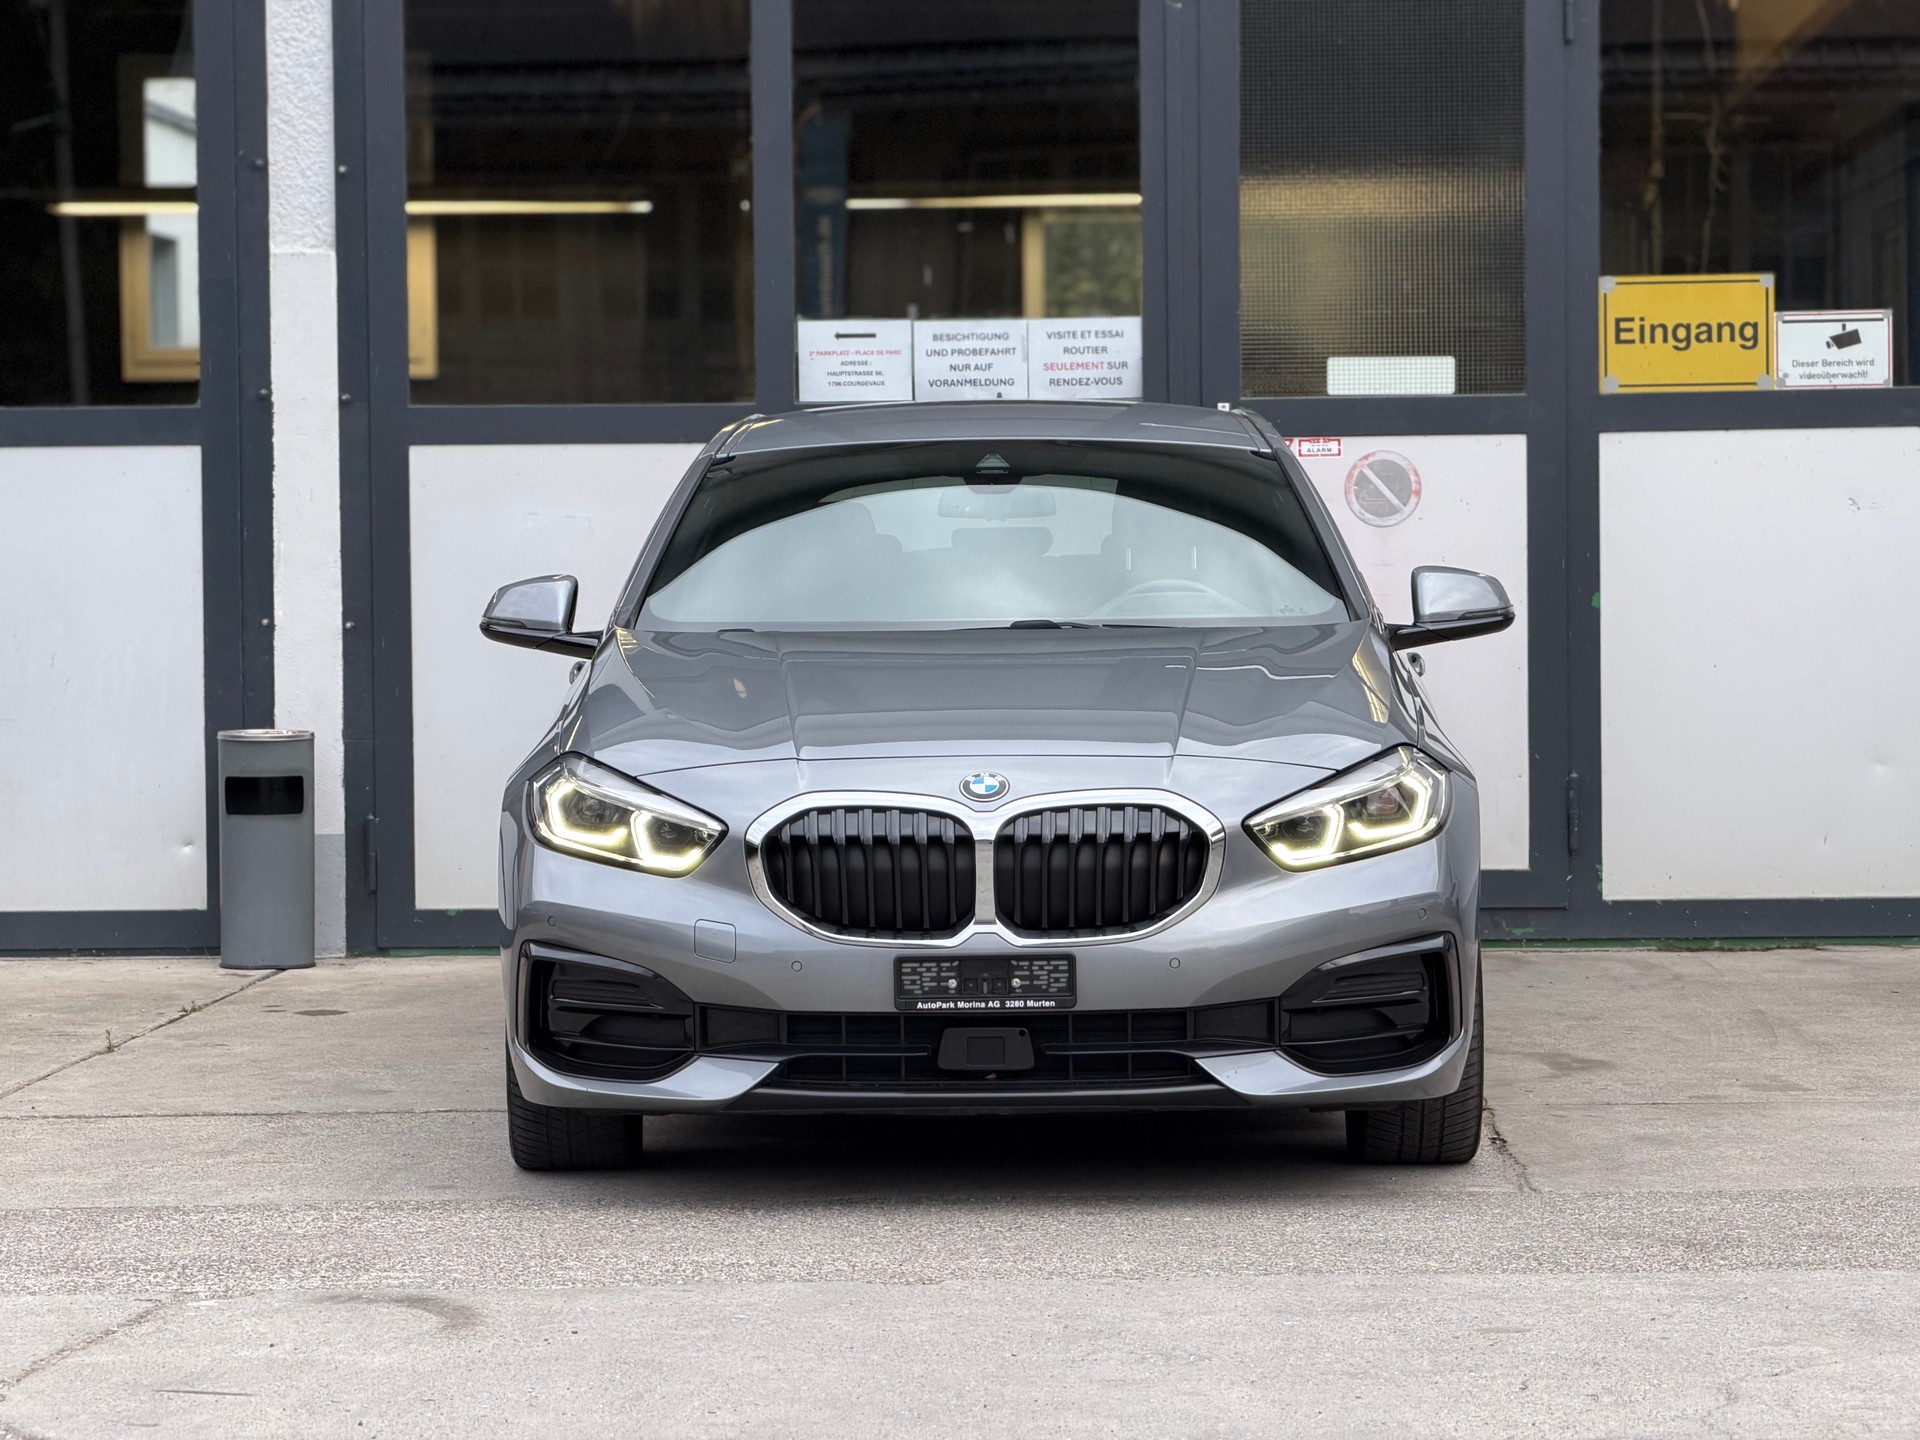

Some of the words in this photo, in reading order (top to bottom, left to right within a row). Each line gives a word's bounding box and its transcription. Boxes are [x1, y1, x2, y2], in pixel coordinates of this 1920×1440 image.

[932, 332, 1009, 342] BESICHTIGUNG
[1046, 331, 1078, 340] VISITE
[1080, 330, 1092, 339] ET
[1094, 329, 1124, 339] ESSAI
[1614, 316, 1759, 351] Eingang
[925, 349, 948, 357] UND
[950, 347, 1017, 356] PROBEFAHRT
[1063, 346, 1108, 355] ROUTIER
[1043, 362, 1105, 371] SEULEMENT
[1106, 361, 1128, 370] SUR
[1792, 359, 1819, 367] Dieser
[1822, 358, 1853, 367] Bereich
[1856, 357, 1875, 366] wird
[949, 363, 972, 372] NUR
[973, 363, 994, 372] AUF
[1799, 370, 1868, 379] videoüberwacht!
[928, 378, 1015, 388] VORANMELDUNG
[1049, 377, 1123, 386] RENDEZ-VOUS
[916, 1001, 955, 1009] AutoPark
[957, 1000, 986, 1008] Morina
[987, 1000, 1000, 1008] AG
[1005, 1000, 1025, 1008] 3280
[1026, 999, 1056, 1007] Murten
